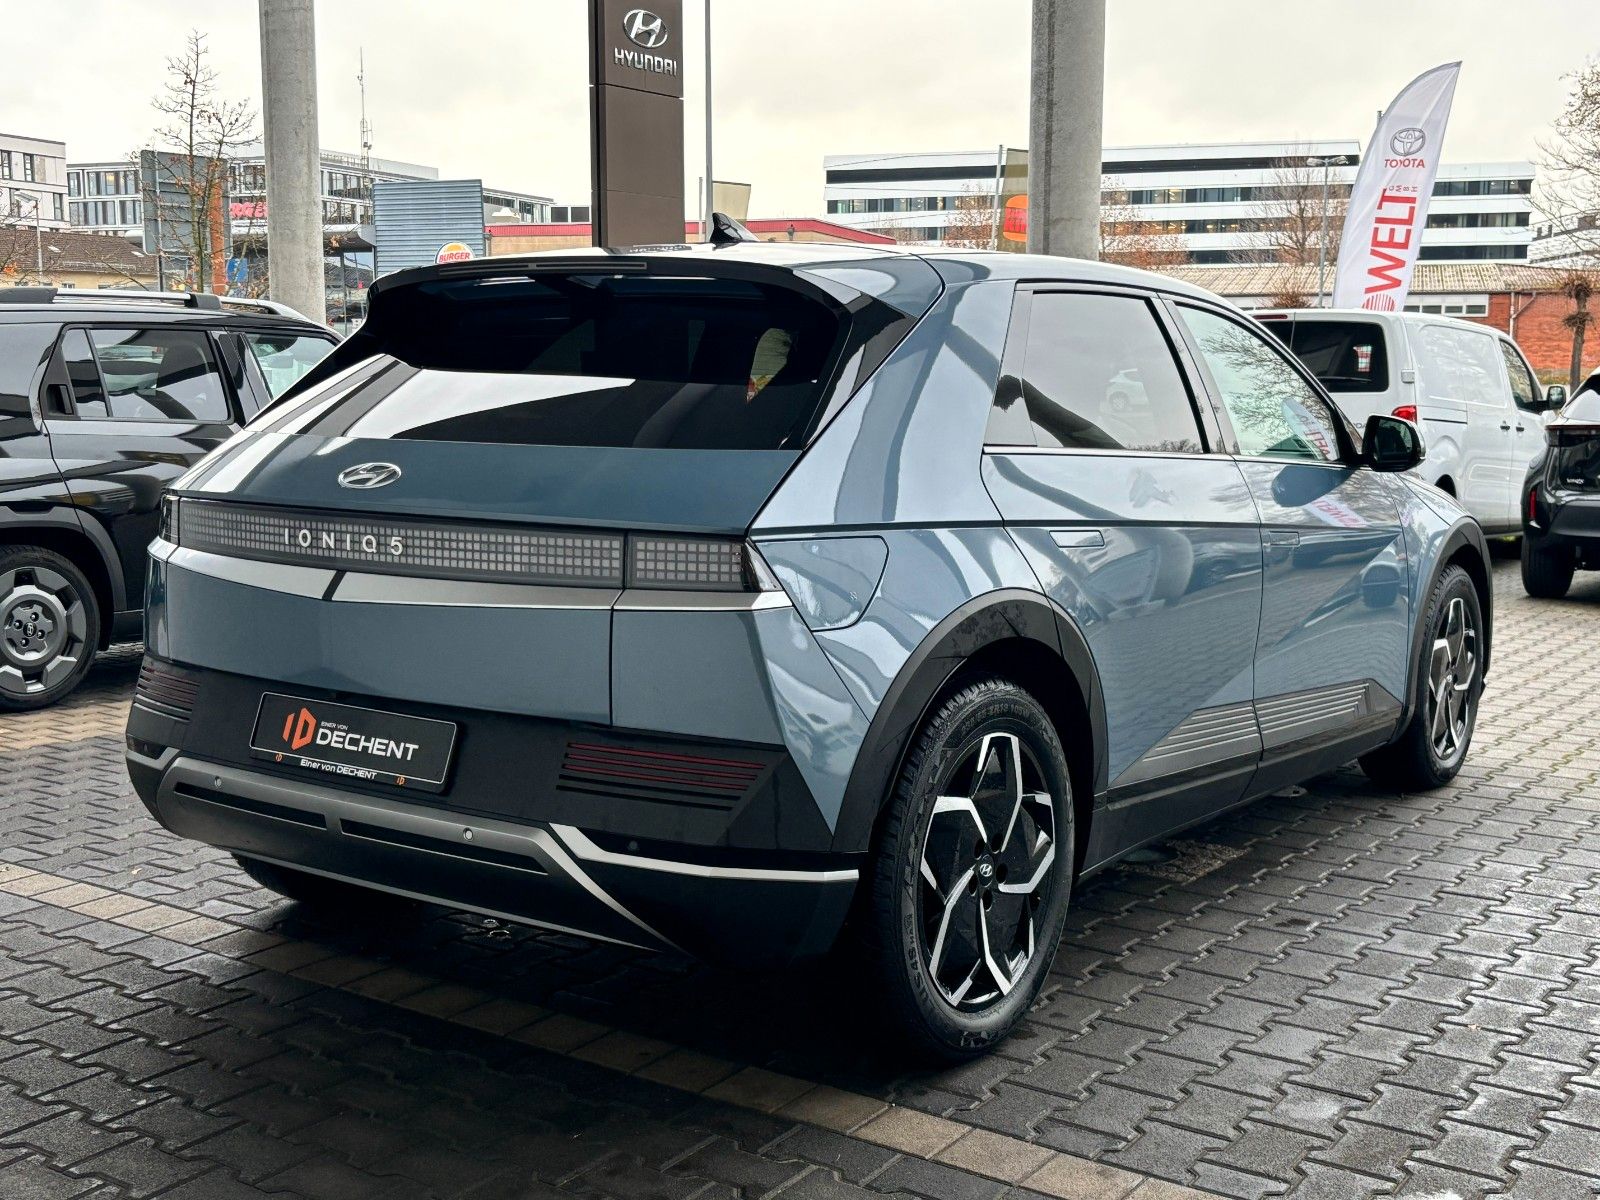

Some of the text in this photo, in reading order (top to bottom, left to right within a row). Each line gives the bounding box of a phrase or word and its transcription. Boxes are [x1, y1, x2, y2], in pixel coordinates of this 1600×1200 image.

[614, 47, 677, 76] HYUNDAI
[1385, 158, 1425, 169] TOYOTA
[1364, 188, 1417, 294] WELT
[438, 252, 471, 263] BURGER
[285, 527, 404, 556] IONIQ 5
[321, 720, 349, 731] EINER VON
[316, 727, 419, 761] DECHENT
[300, 758, 377, 780] Einer von DECHENT
